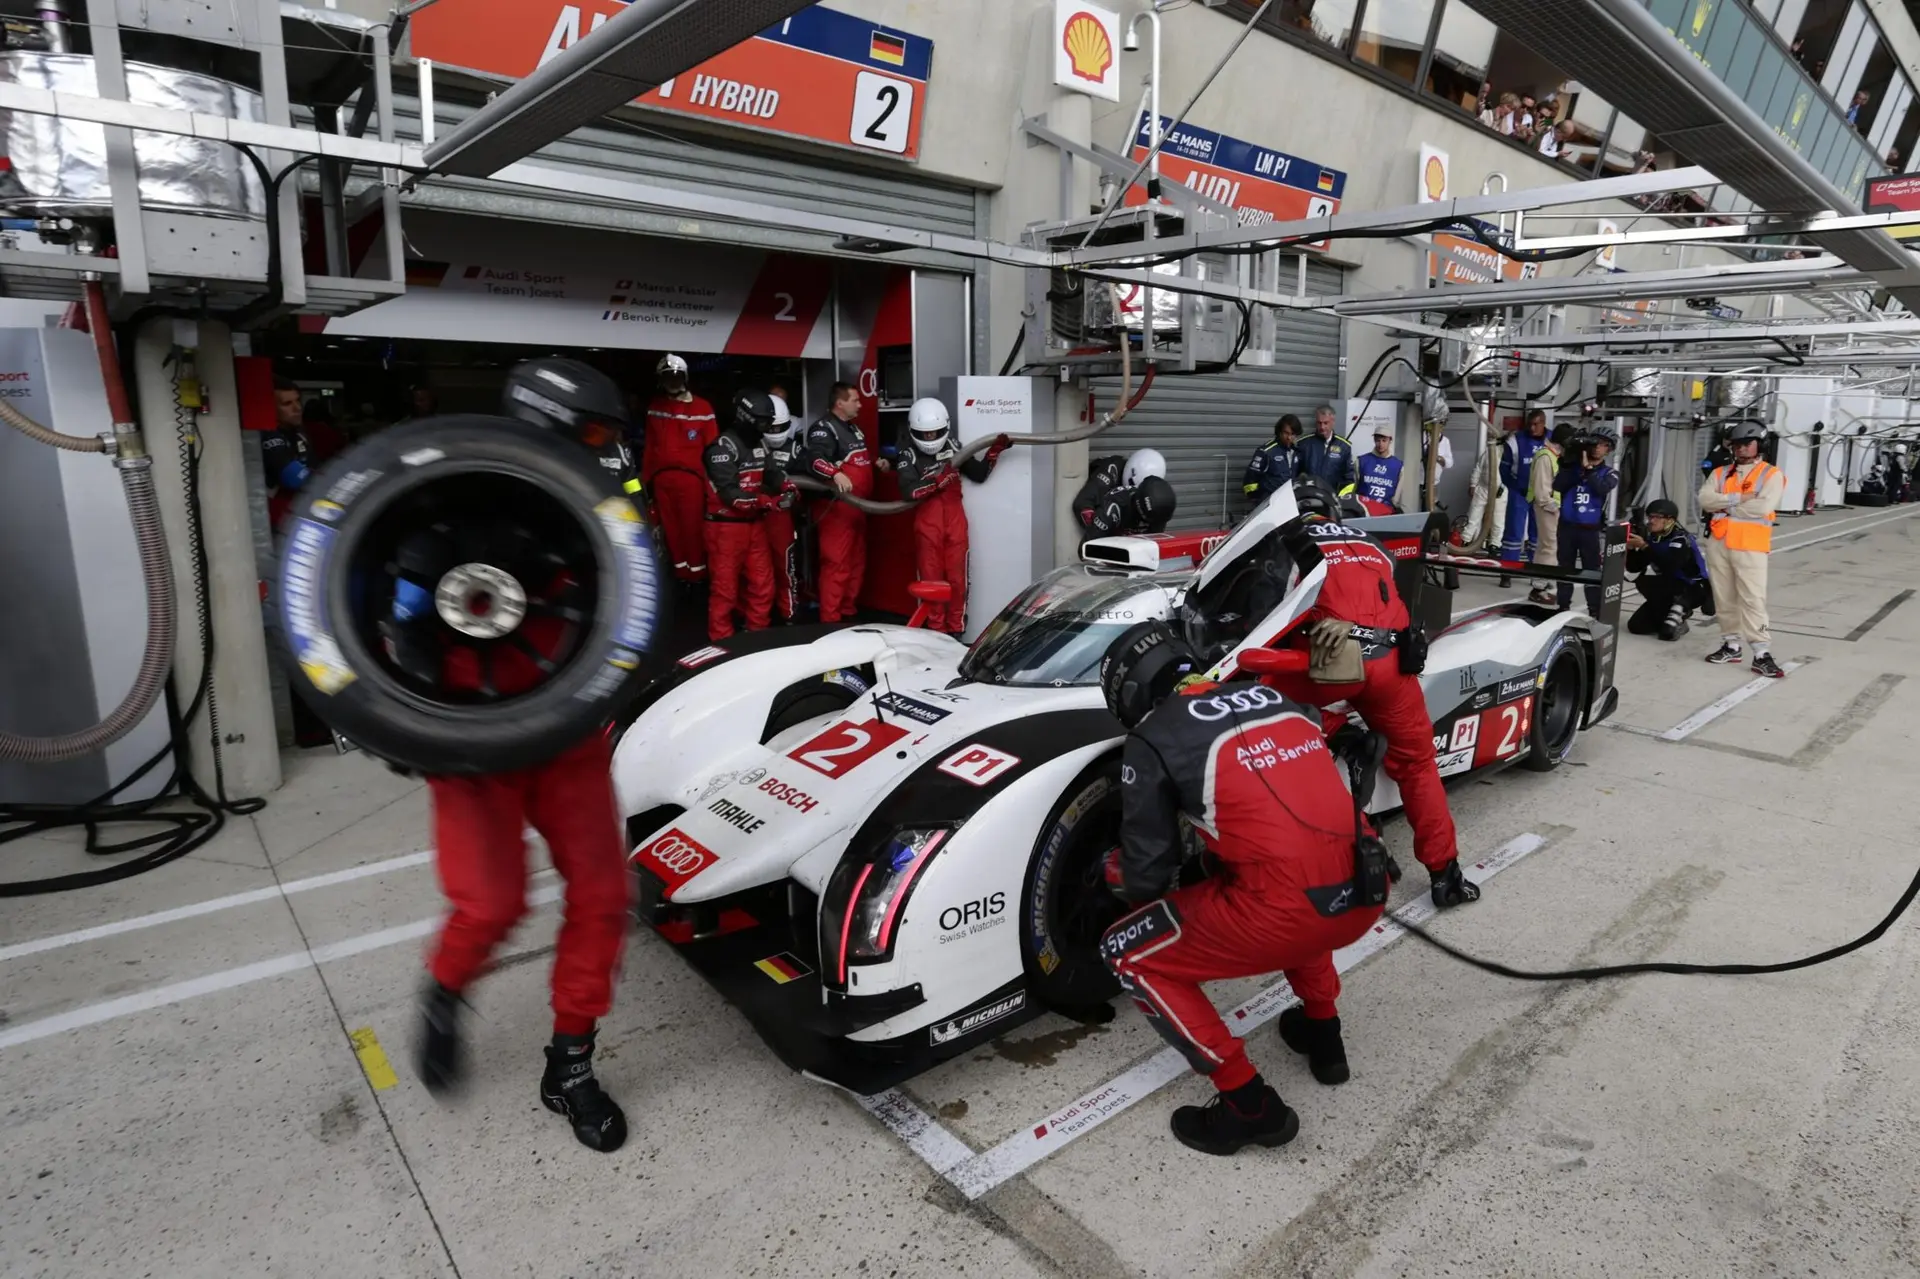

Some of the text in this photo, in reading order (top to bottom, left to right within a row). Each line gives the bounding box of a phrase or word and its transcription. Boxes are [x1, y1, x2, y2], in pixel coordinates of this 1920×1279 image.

[689, 73, 779, 119] HYBRID
[864, 84, 899, 141] 2
[1181, 133, 1213, 153] MANS
[1254, 151, 1291, 179] LM P1
[484, 270, 567, 286] Audi Sport
[484, 282, 565, 300] Team Joest
[631, 295, 714, 312] André Lotterer
[774, 292, 797, 321] 2
[1119, 282, 1143, 312] 2
[662, 314, 708, 328] Tréluyer
[976, 407, 1022, 416] Team Joest
[997, 399, 1022, 407] Sport
[1363, 475, 1393, 488] MARSHAL
[1369, 485, 1386, 498] 735
[1325, 549, 1344, 558] udi
[1460, 665, 1477, 690] itk
[910, 707, 940, 721] MANS
[1455, 720, 1475, 746] P1
[1496, 705, 1518, 757] 2
[800, 727, 872, 774] 2
[951, 749, 1005, 777] P1
[1237, 737, 1276, 762] Audi
[1240, 754, 1277, 771] Top
[757, 777, 820, 814] BOSCH
[708, 798, 766, 834] MAHLE
[1034, 826, 1064, 938] MICHELIN
[939, 891, 1006, 931] ORIS
[939, 915, 1006, 945] Swiss Watches
[1107, 915, 1153, 953] Sport
[961, 994, 1024, 1029] MICHELIN
[1245, 996, 1268, 1012] Audi
[1254, 999, 1284, 1017] Team
[884, 1093, 917, 1121] Sport
[1049, 1086, 1118, 1129] Audi Sport
[1057, 1091, 1133, 1137] Team Joest
